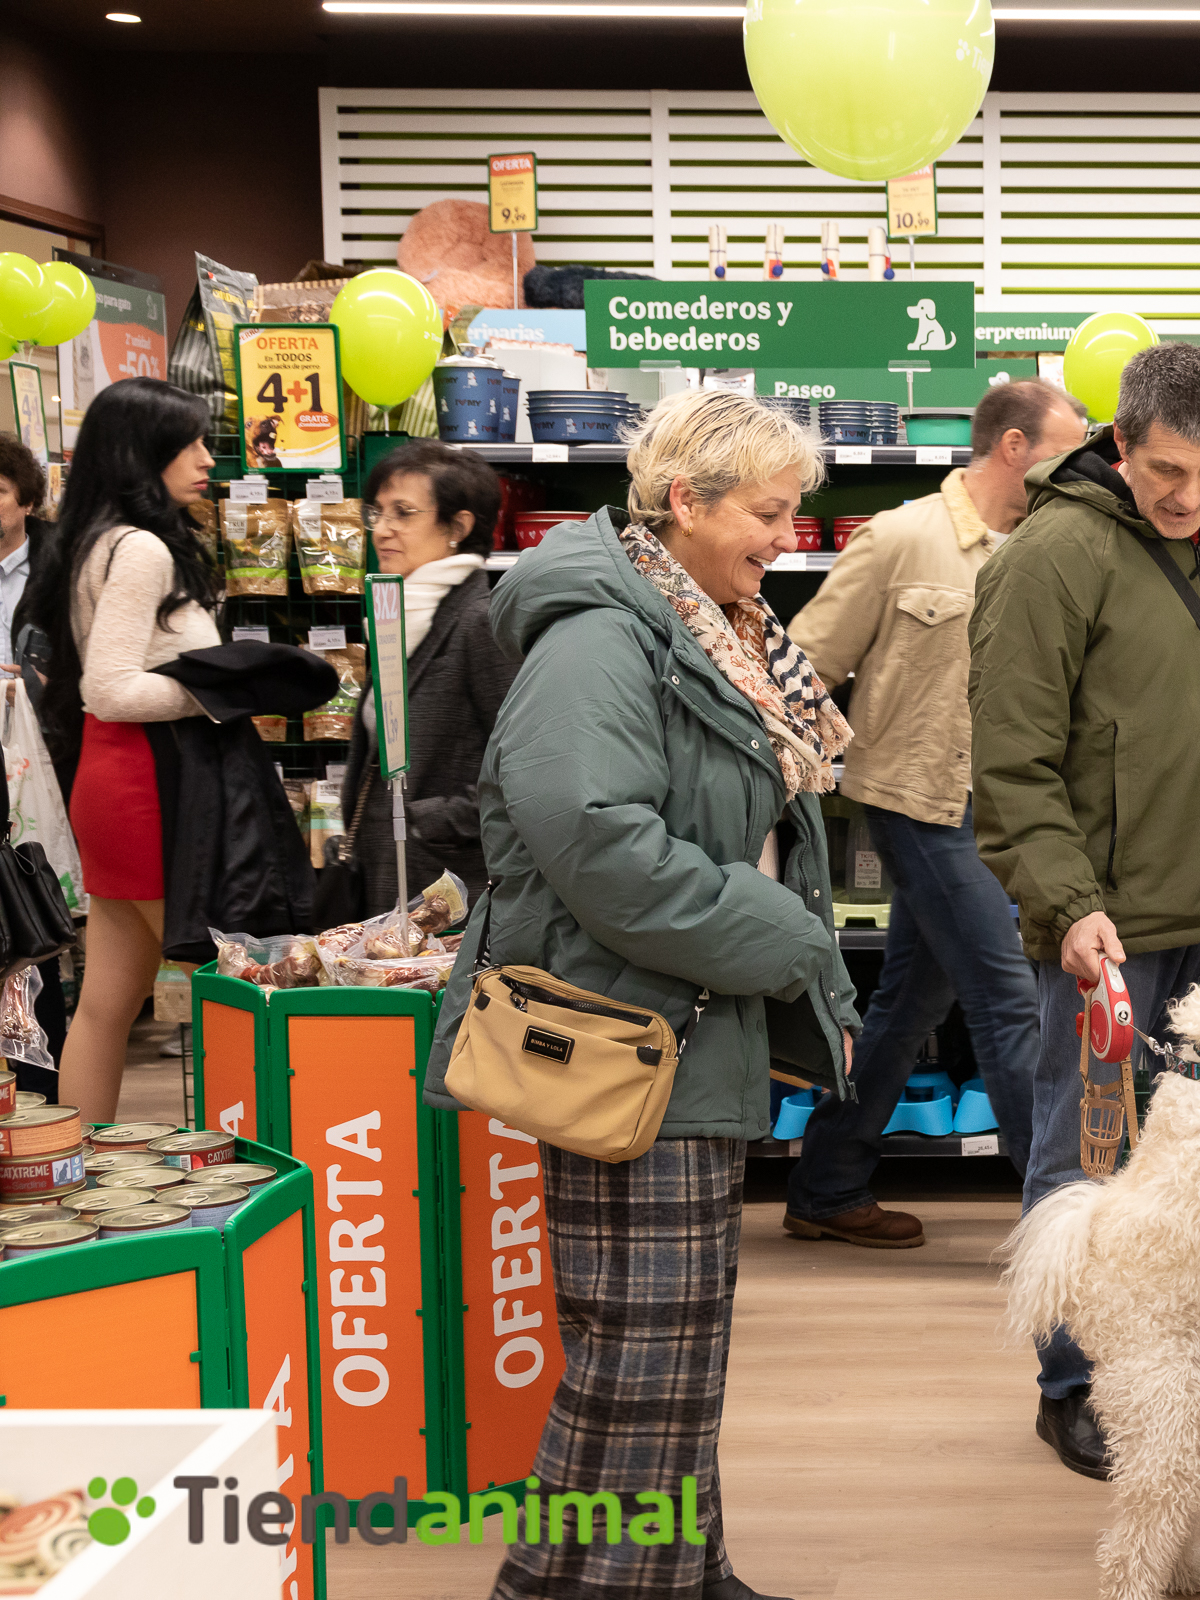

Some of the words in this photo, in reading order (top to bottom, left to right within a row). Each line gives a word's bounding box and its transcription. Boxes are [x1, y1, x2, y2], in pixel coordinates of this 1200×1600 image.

[492, 158, 532, 171] OFERTA
[608, 296, 771, 321] Comederos
[777, 300, 794, 326] y
[466, 323, 546, 342] erinarias
[609, 326, 761, 352] bebederos
[974, 322, 1077, 345] erpremium
[256, 337, 319, 350] OFERTA
[275, 353, 312, 361] TODOS
[257, 372, 323, 413] 4+1
[774, 381, 836, 399] Paseo
[530, 1038, 546, 1047] BIMBA
[550, 1044, 563, 1052] LOLA
[207, 1148, 235, 1165] CATXTR
[12, 1180, 47, 1190] Sardine
[325, 1109, 390, 1406] OFERTA
